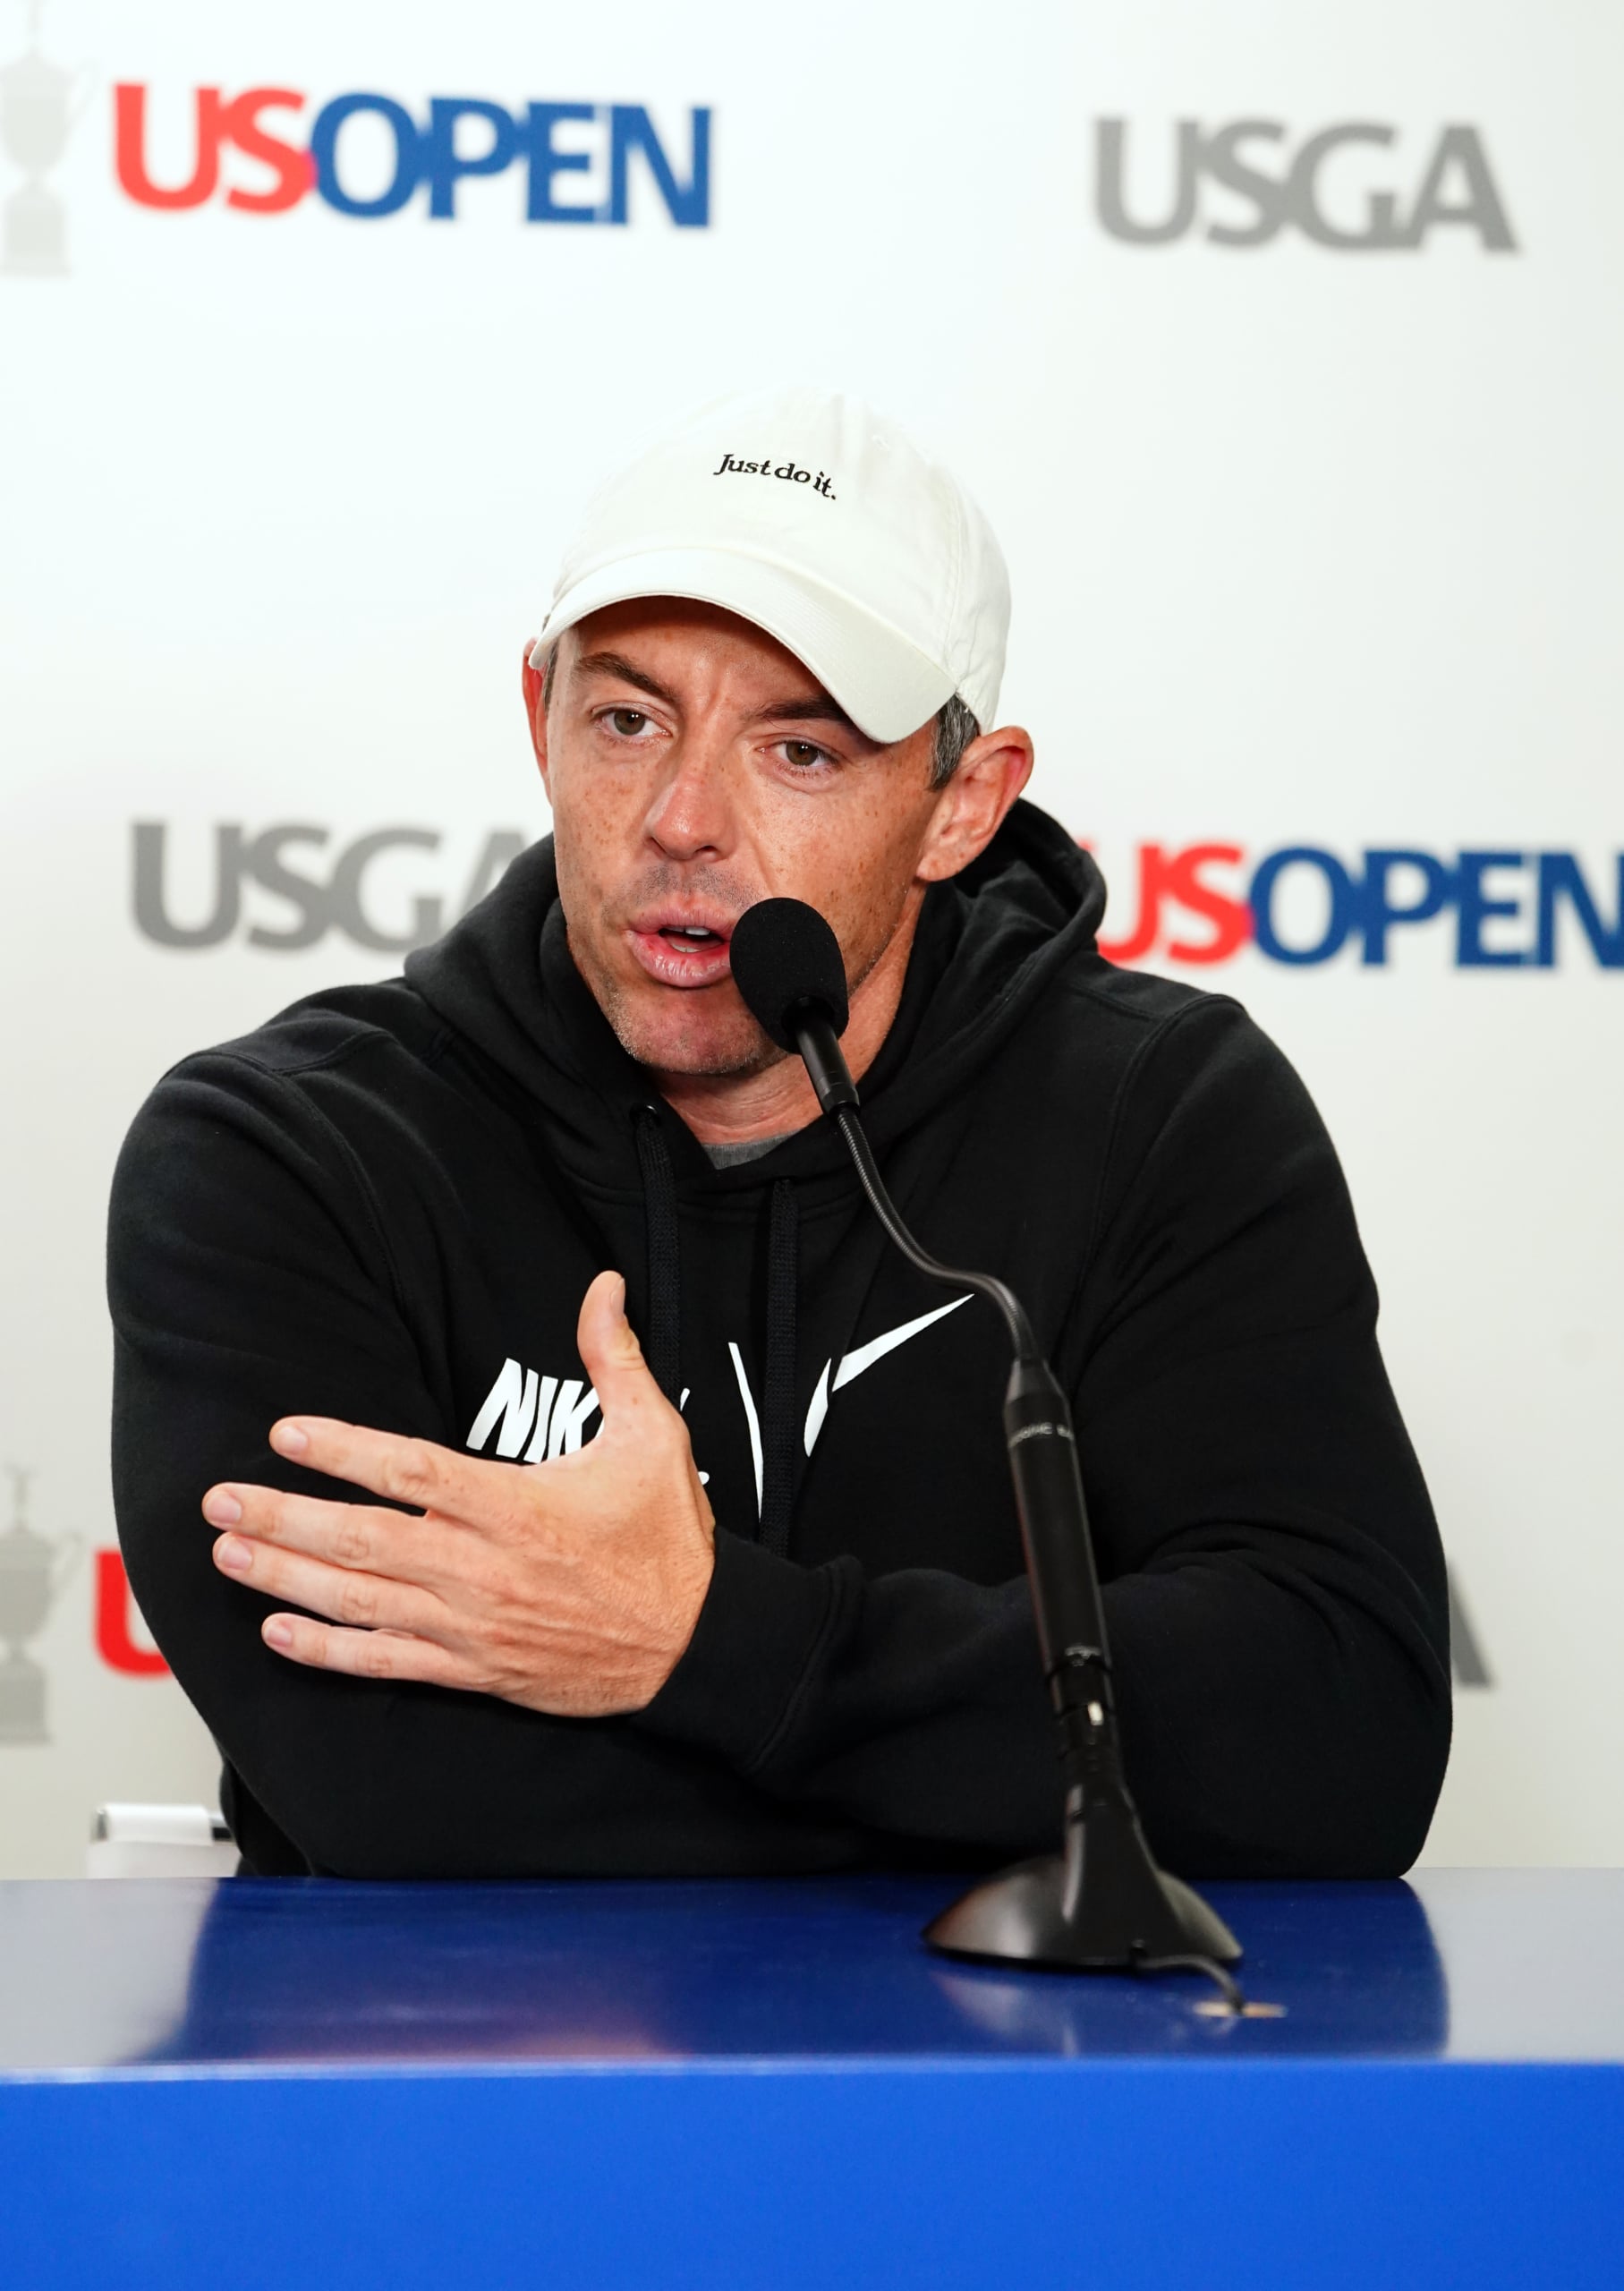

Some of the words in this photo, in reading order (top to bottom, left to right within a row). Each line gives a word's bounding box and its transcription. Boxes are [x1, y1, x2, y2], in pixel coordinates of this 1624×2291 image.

[1093, 117, 1520, 252] USGA
[713, 454, 771, 475] Just
[774, 463, 812, 483] do
[812, 471, 837, 500] it.
[465, 1358, 606, 1465] NIK
